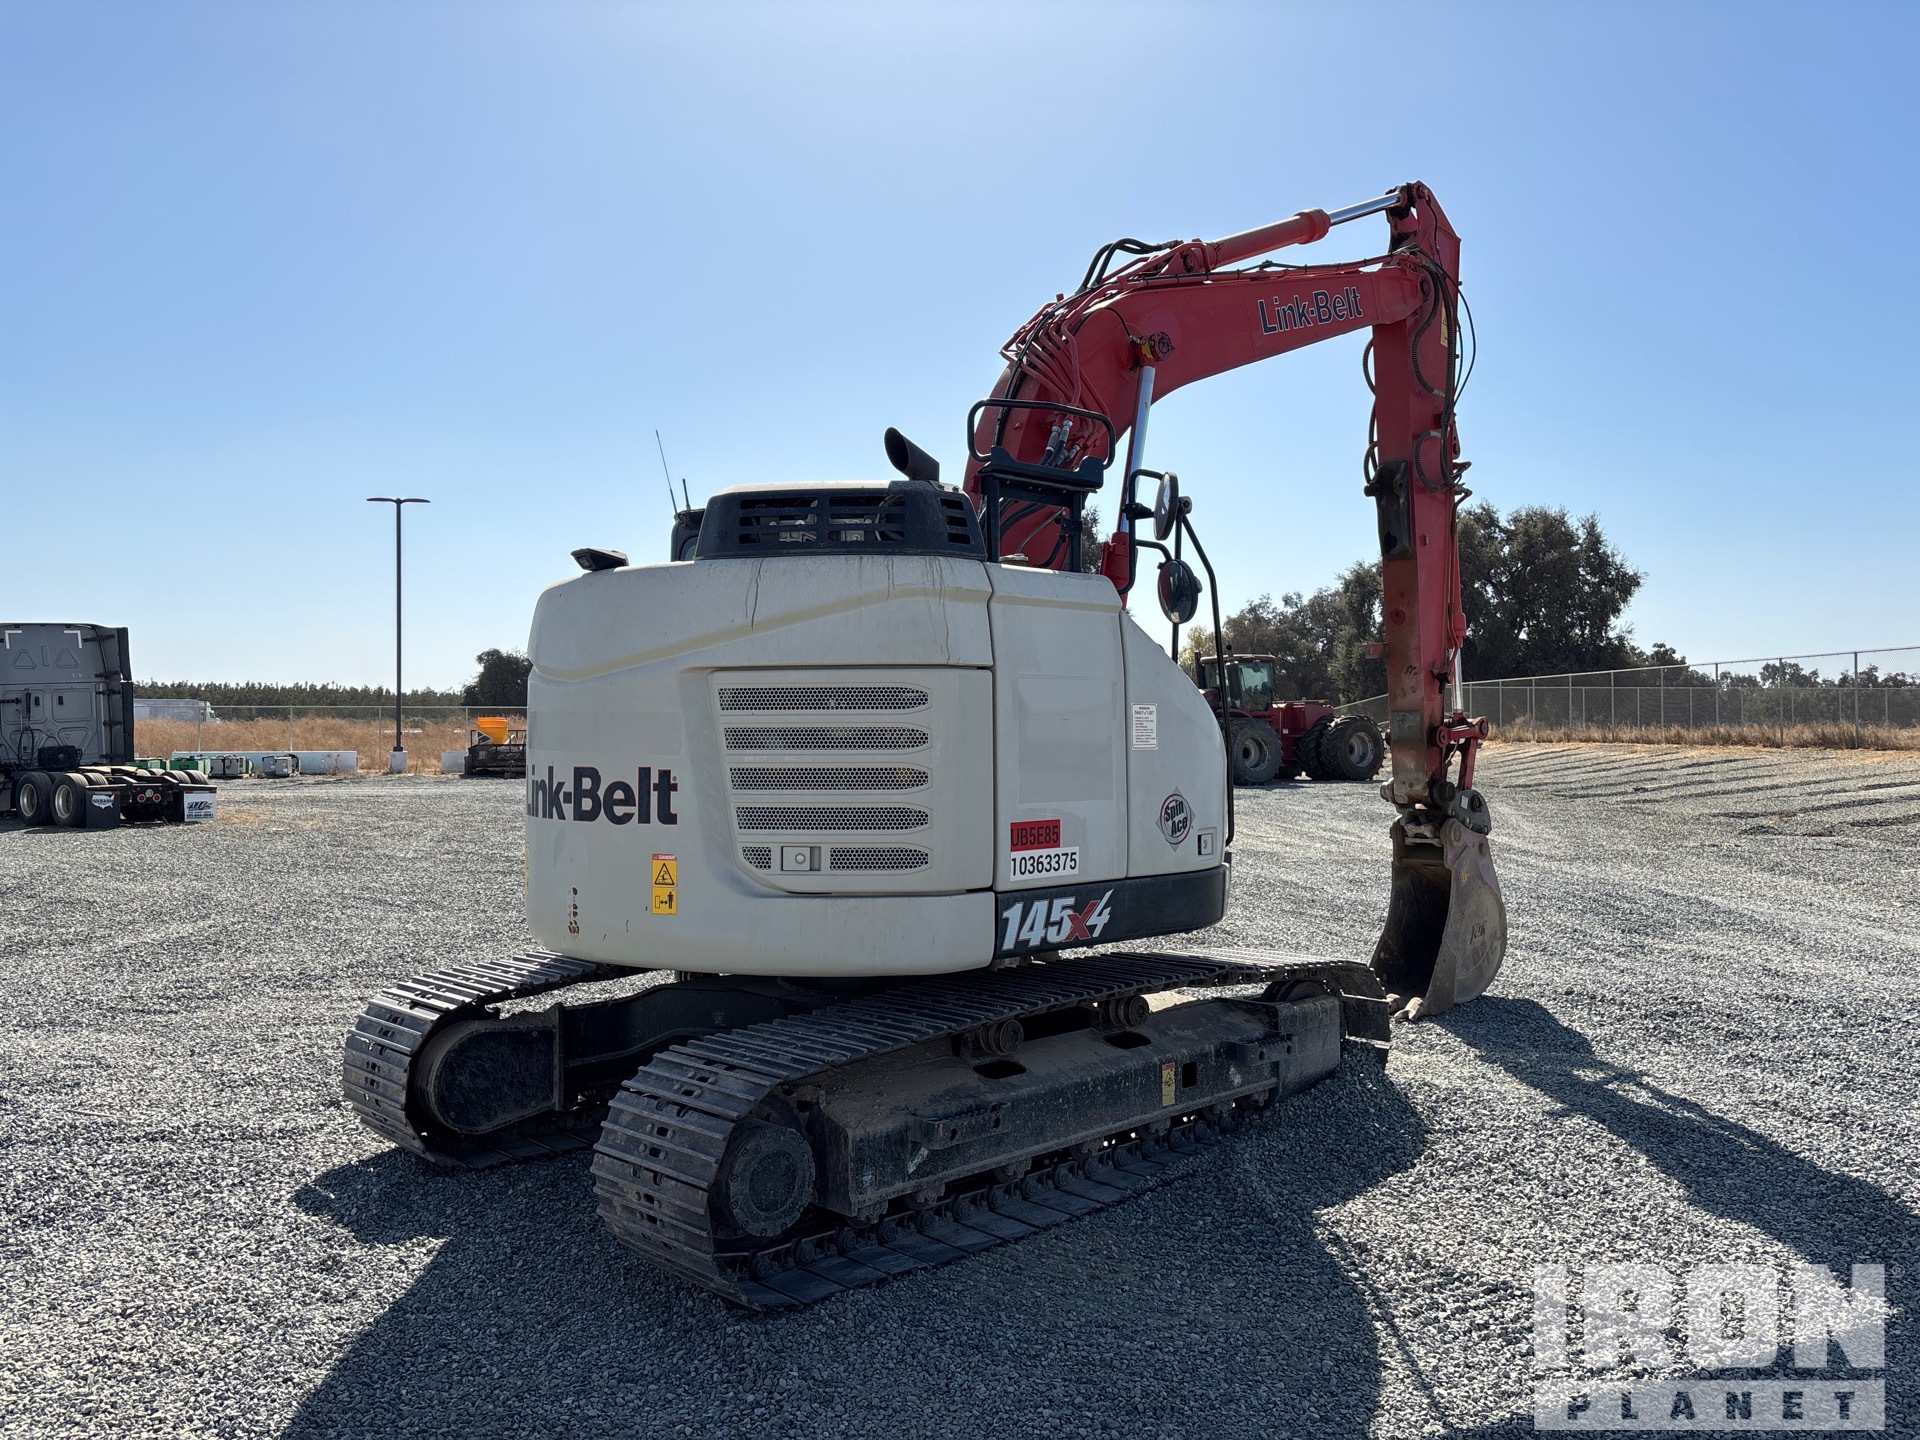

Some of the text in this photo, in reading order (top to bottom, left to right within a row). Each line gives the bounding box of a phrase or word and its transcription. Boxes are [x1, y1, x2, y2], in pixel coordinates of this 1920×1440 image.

[1258, 286, 1363, 335] Link-Belt
[1164, 800, 1184, 822] Spin
[1010, 825, 1059, 847] UB5E85
[1171, 816, 1188, 837] Ace
[1011, 851, 1077, 876] 10363375
